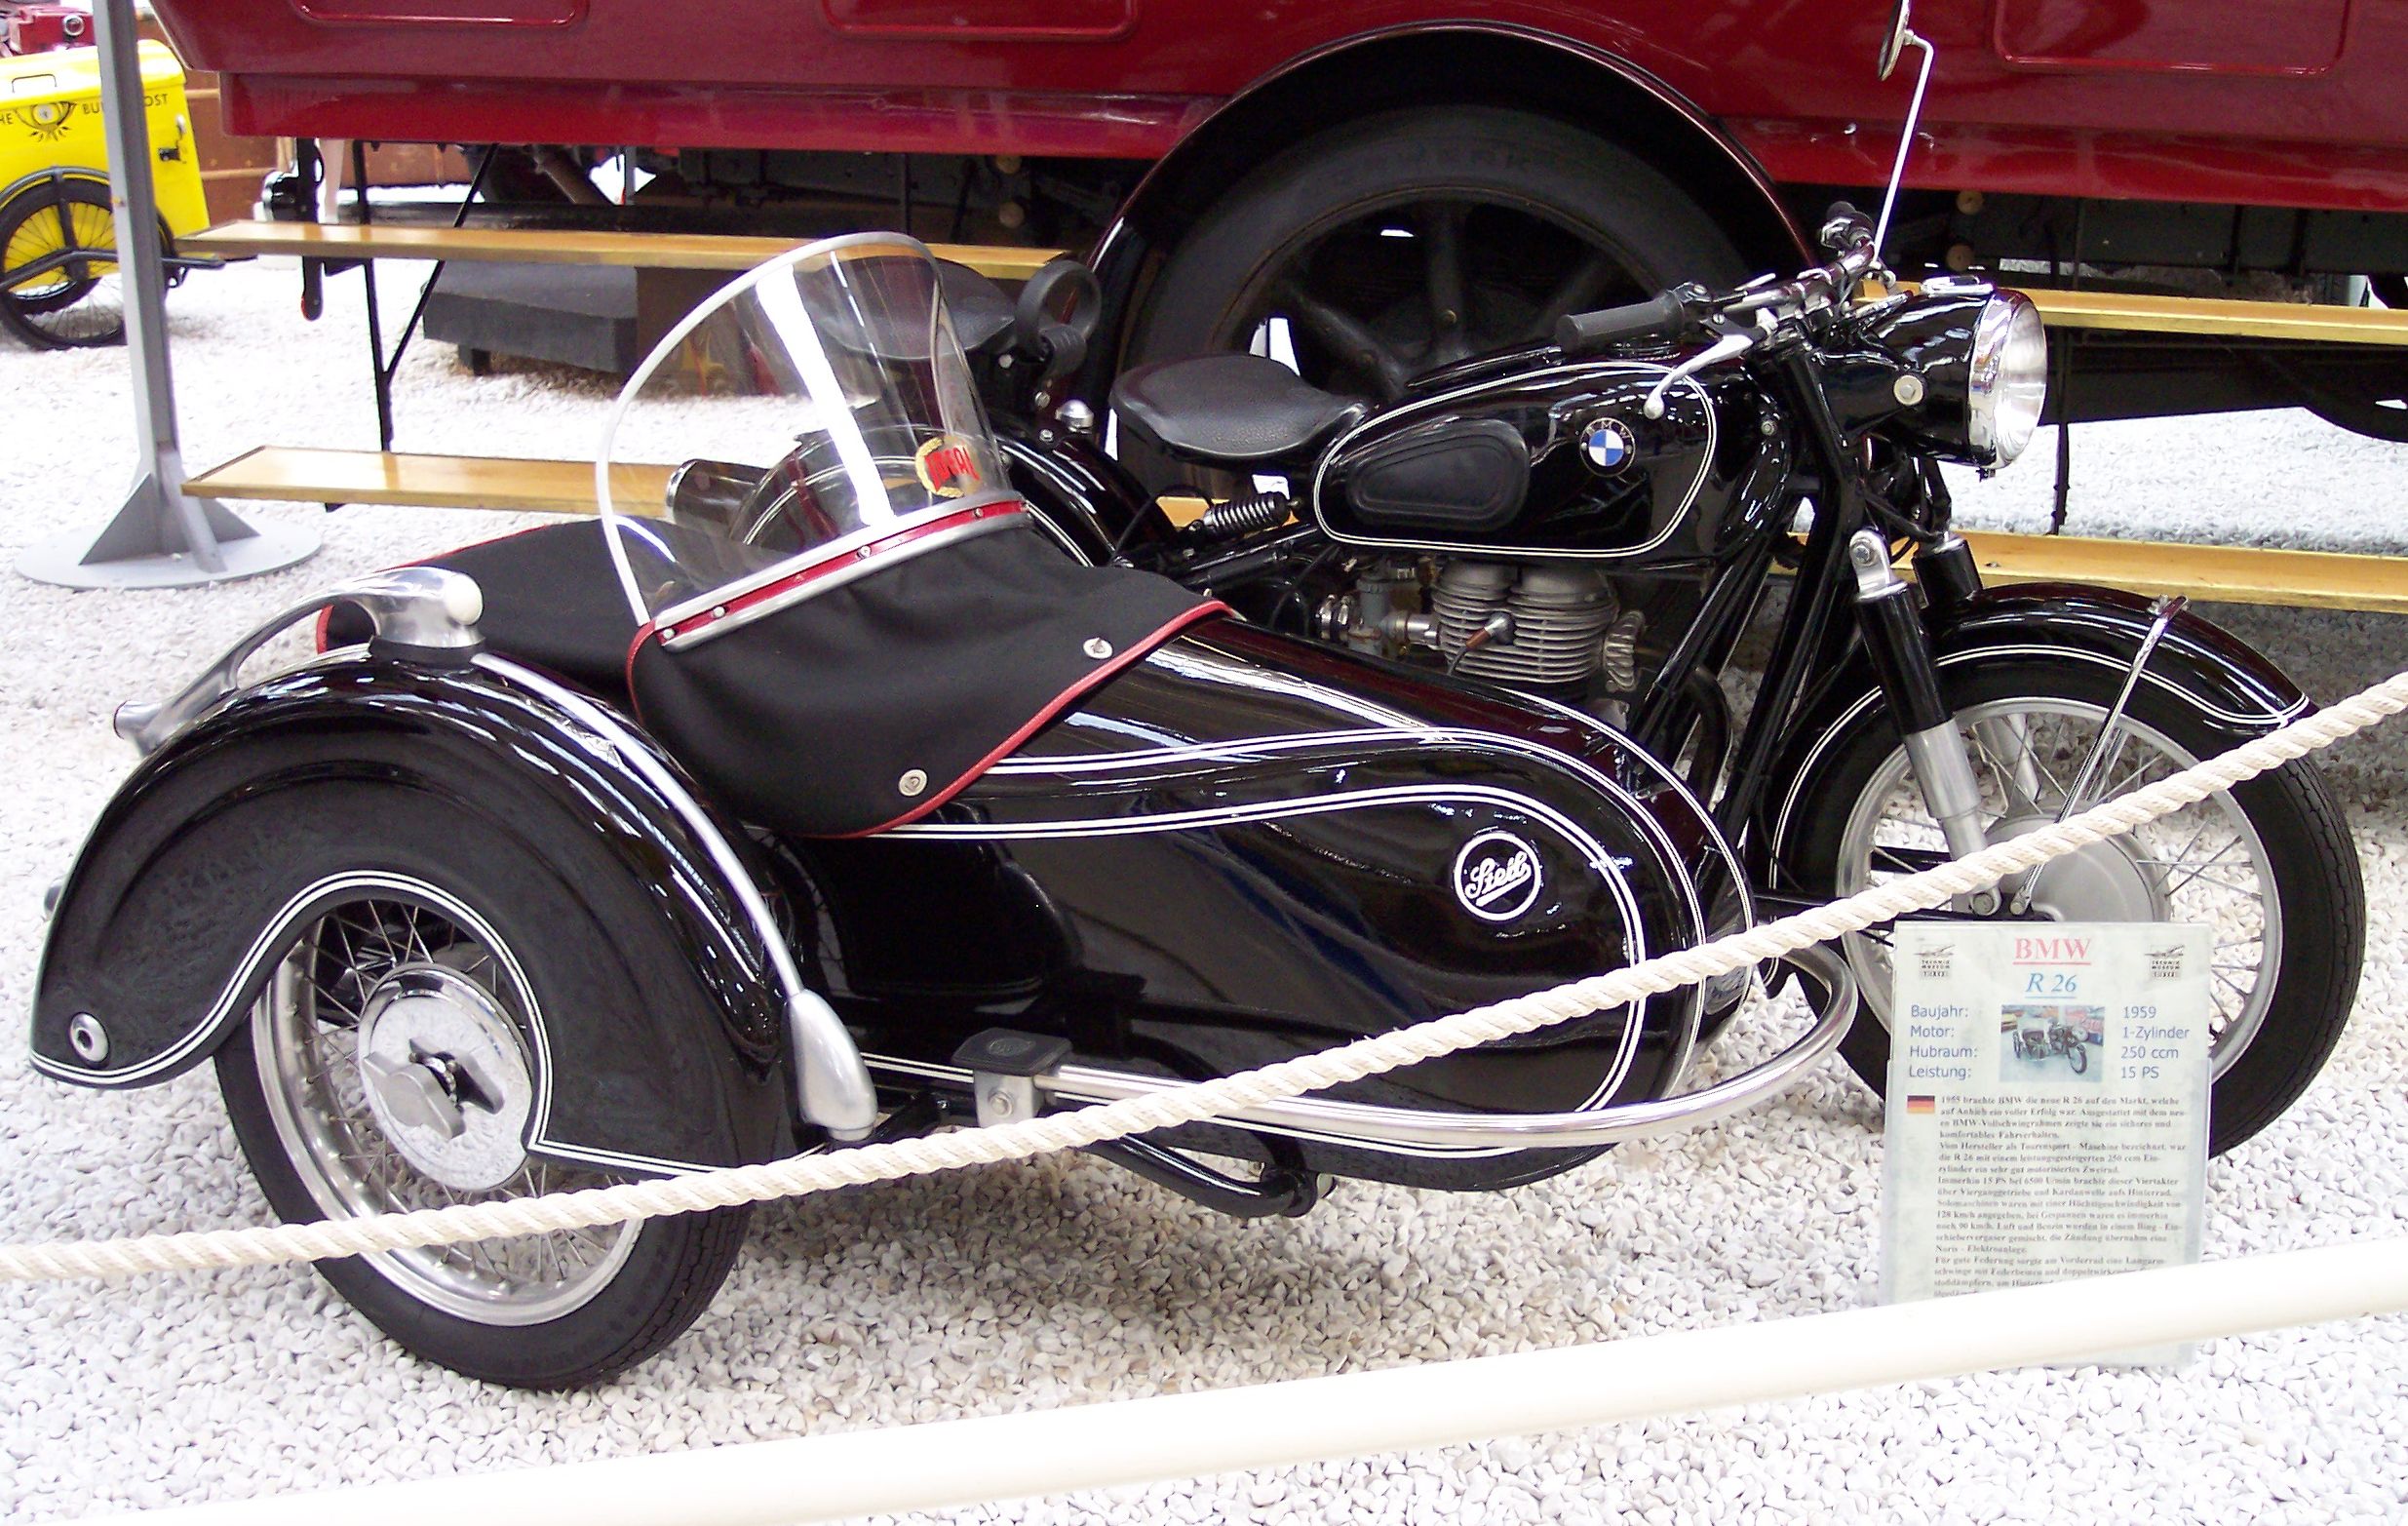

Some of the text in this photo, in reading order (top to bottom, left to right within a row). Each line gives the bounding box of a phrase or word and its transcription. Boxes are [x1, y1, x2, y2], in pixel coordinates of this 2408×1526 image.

[1585, 419, 1631, 439] BMW
[2014, 937, 2092, 959] BMW
[2025, 973, 2078, 993] R 26
[1911, 1004, 1968, 1021] Baujahr:
[2123, 1005, 2156, 1019] 1959
[1910, 1026, 1955, 1038] Motor:
[2122, 1026, 2190, 1041] 1-Zylinder
[1909, 1044, 1978, 1058] Hubraum:
[2120, 1046, 2179, 1059] 250 ccm
[1908, 1066, 1971, 1081] Leistung:
[2120, 1066, 2159, 1079] 15 PS
[1962, 1096, 1996, 1105] brachte
[1999, 1096, 2022, 1105] BMW
[2025, 1096, 2039, 1105] die
[2063, 1096, 2070, 1105] R
[2073, 1096, 2082, 1105] 26
[2085, 1096, 2100, 1105] auf
[2151, 1096, 2179, 1105] welche
[1941, 1108, 1955, 1116] auf
[1990, 1108, 2002, 1116] ein
[2031, 1108, 2056, 1116] Erfolg
[2150, 1108, 2167, 1116] dem
[1961, 1142, 2002, 1151] Hersteller
[2005, 1142, 2017, 1151] als
[2079, 1142, 2118, 1151] Maschine
[1990, 1165, 2008, 1174] sehr
[2010, 1165, 2025, 1174] gut
[1938, 1176, 1980, 1185] Immerhin
[1983, 1176, 1993, 1185] 15
[1996, 1176, 2006, 1185] PS
[2009, 1176, 2022, 1185] bei
[2074, 1176, 2106, 1185] brachte
[2135, 1176, 2179, 1185] Viertakter
[1997, 1222, 2015, 1231] Luft
[2017, 1222, 2034, 1231] und
